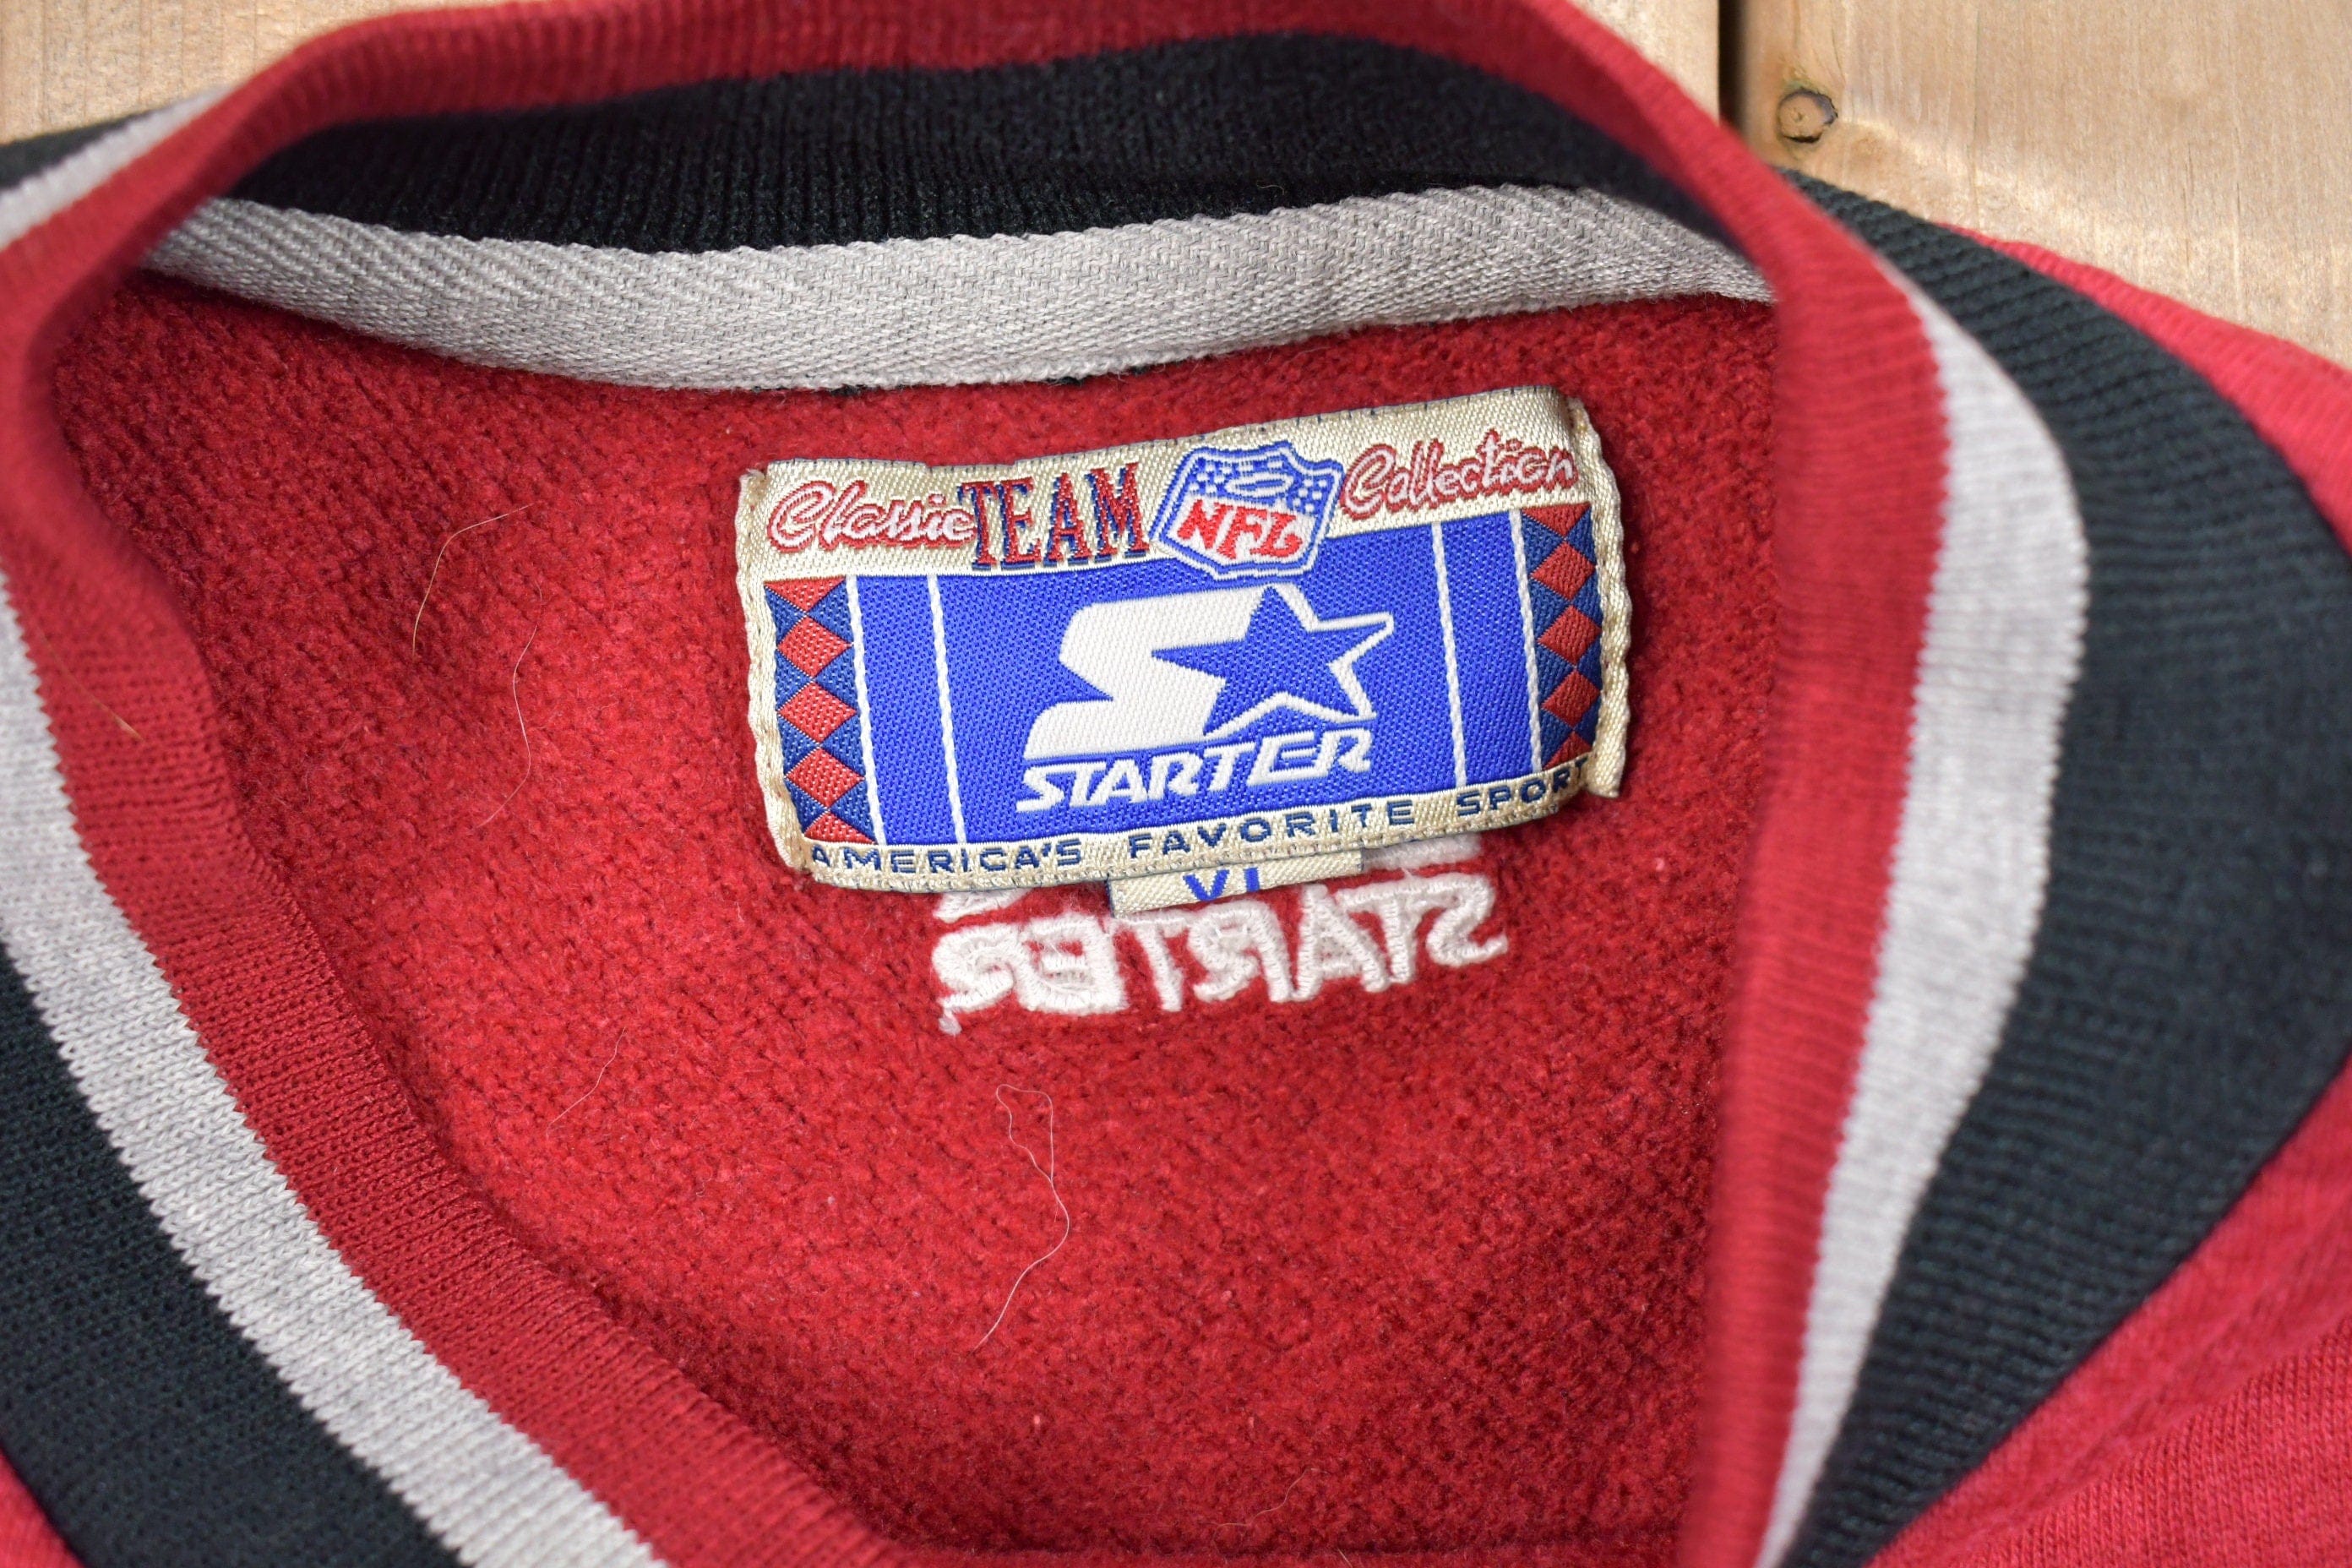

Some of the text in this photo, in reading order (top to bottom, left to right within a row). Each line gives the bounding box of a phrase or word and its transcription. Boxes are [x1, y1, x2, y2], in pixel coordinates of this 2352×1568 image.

[767, 428, 1578, 572] Classic TEAM NFL Collection
[1016, 727, 1374, 813] STARTER
[811, 838, 1082, 874] AMERICA'S
[1128, 799, 1415, 860] FAVORITE
